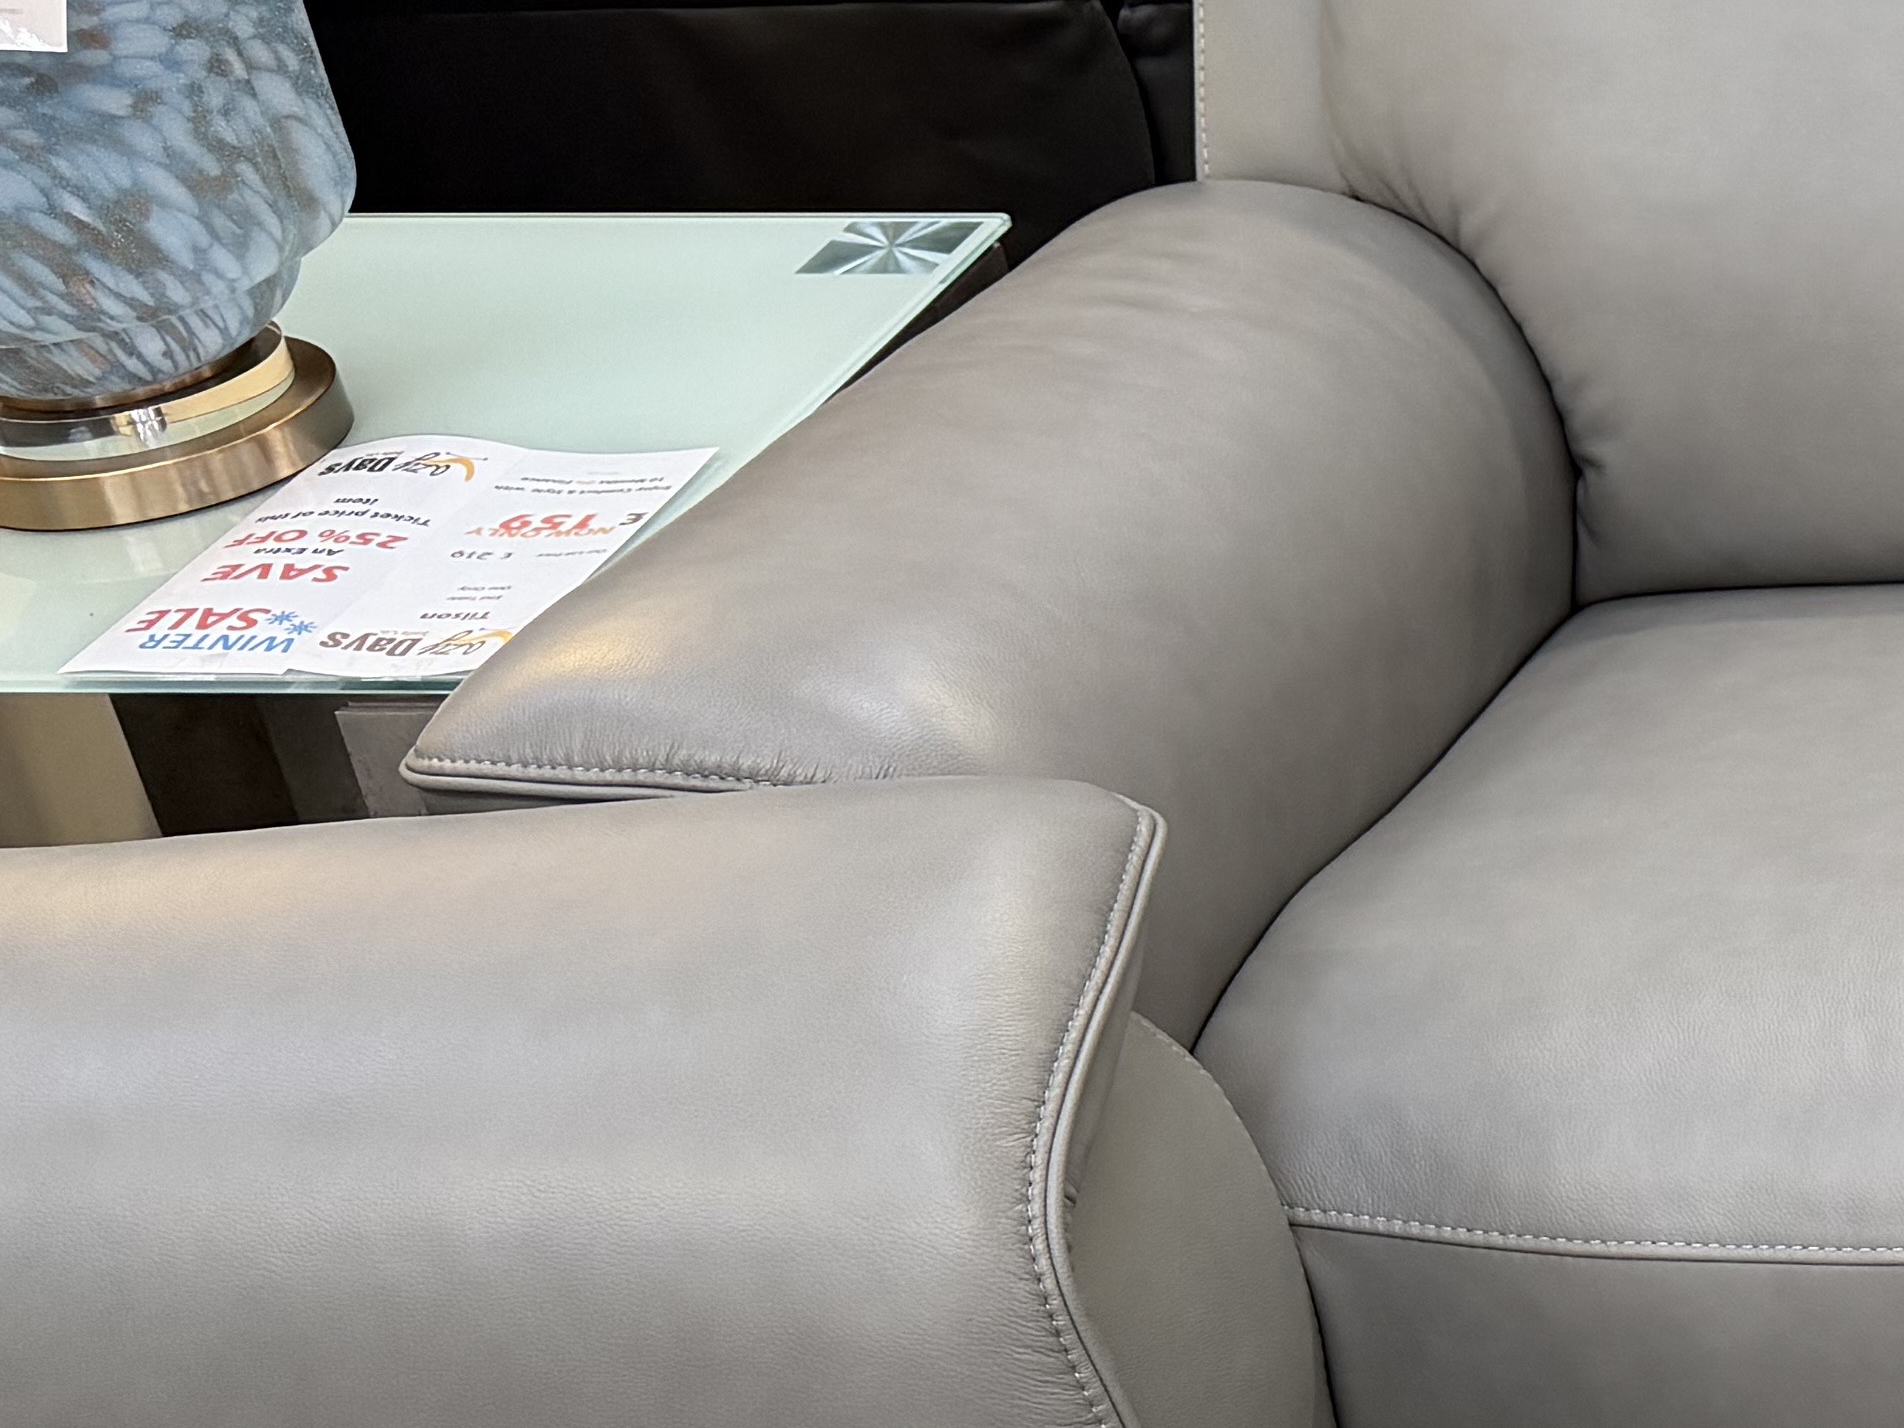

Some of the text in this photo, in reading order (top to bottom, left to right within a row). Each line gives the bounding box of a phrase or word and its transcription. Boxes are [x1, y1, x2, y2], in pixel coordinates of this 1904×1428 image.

[318, 456, 399, 476] Days
[333, 498, 379, 506] item
[255, 508, 432, 528] Ticket price of this
[498, 511, 649, 530] £ 159
[224, 528, 409, 549] 25% OFF
[464, 526, 618, 539] NOW ONLY
[253, 545, 345, 556] An Extra
[201, 562, 350, 583] SAVE
[125, 607, 272, 634] SALE
[420, 611, 491, 621] Tilson
[138, 632, 297, 654] WINTER
[320, 630, 424, 657] Days
